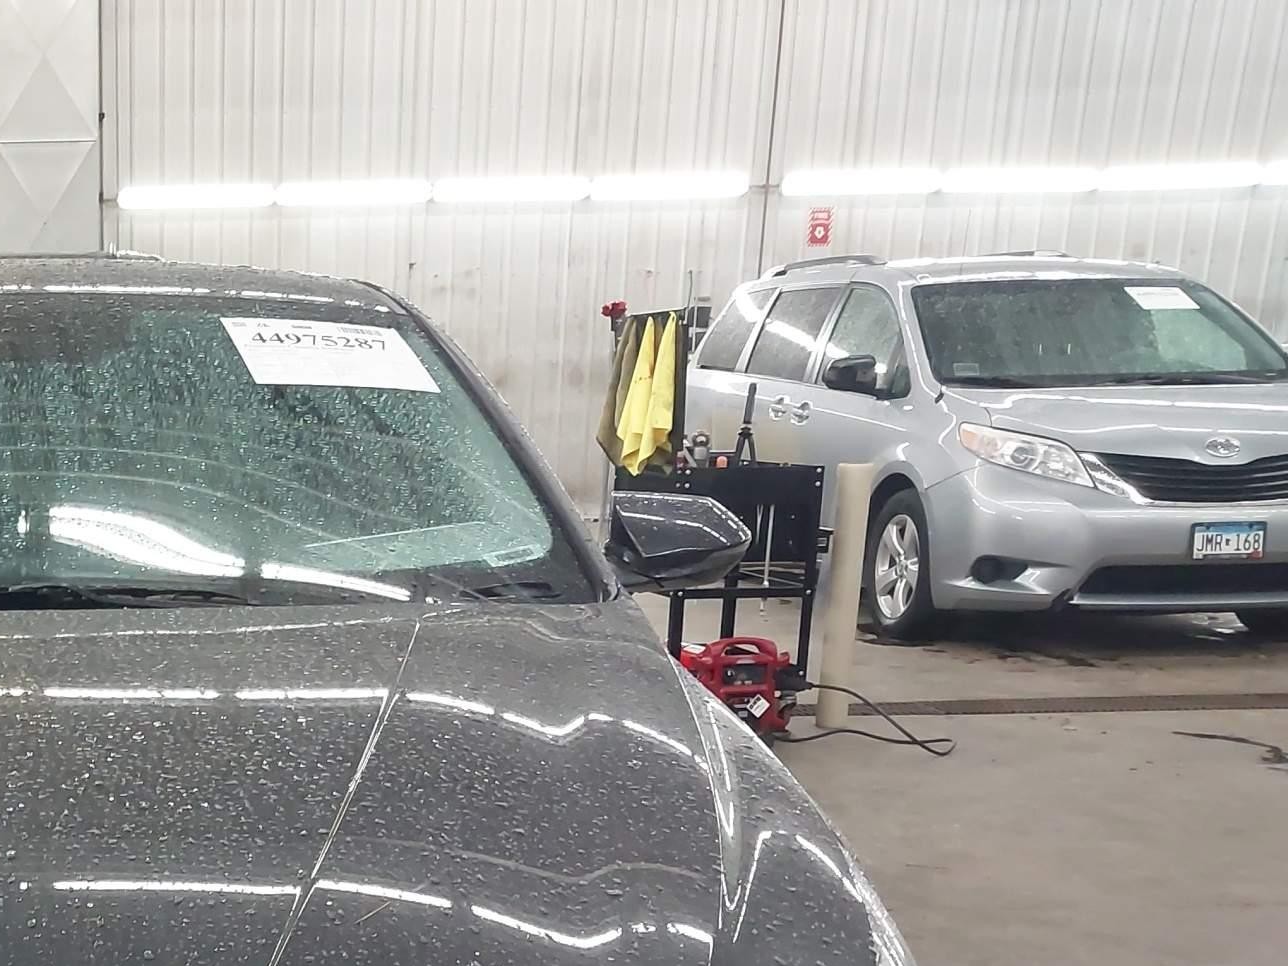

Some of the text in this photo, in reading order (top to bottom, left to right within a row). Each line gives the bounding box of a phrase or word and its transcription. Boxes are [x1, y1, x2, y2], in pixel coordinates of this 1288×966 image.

[252, 331, 386, 351] 44975287
[1196, 532, 1261, 552] JMR 168
